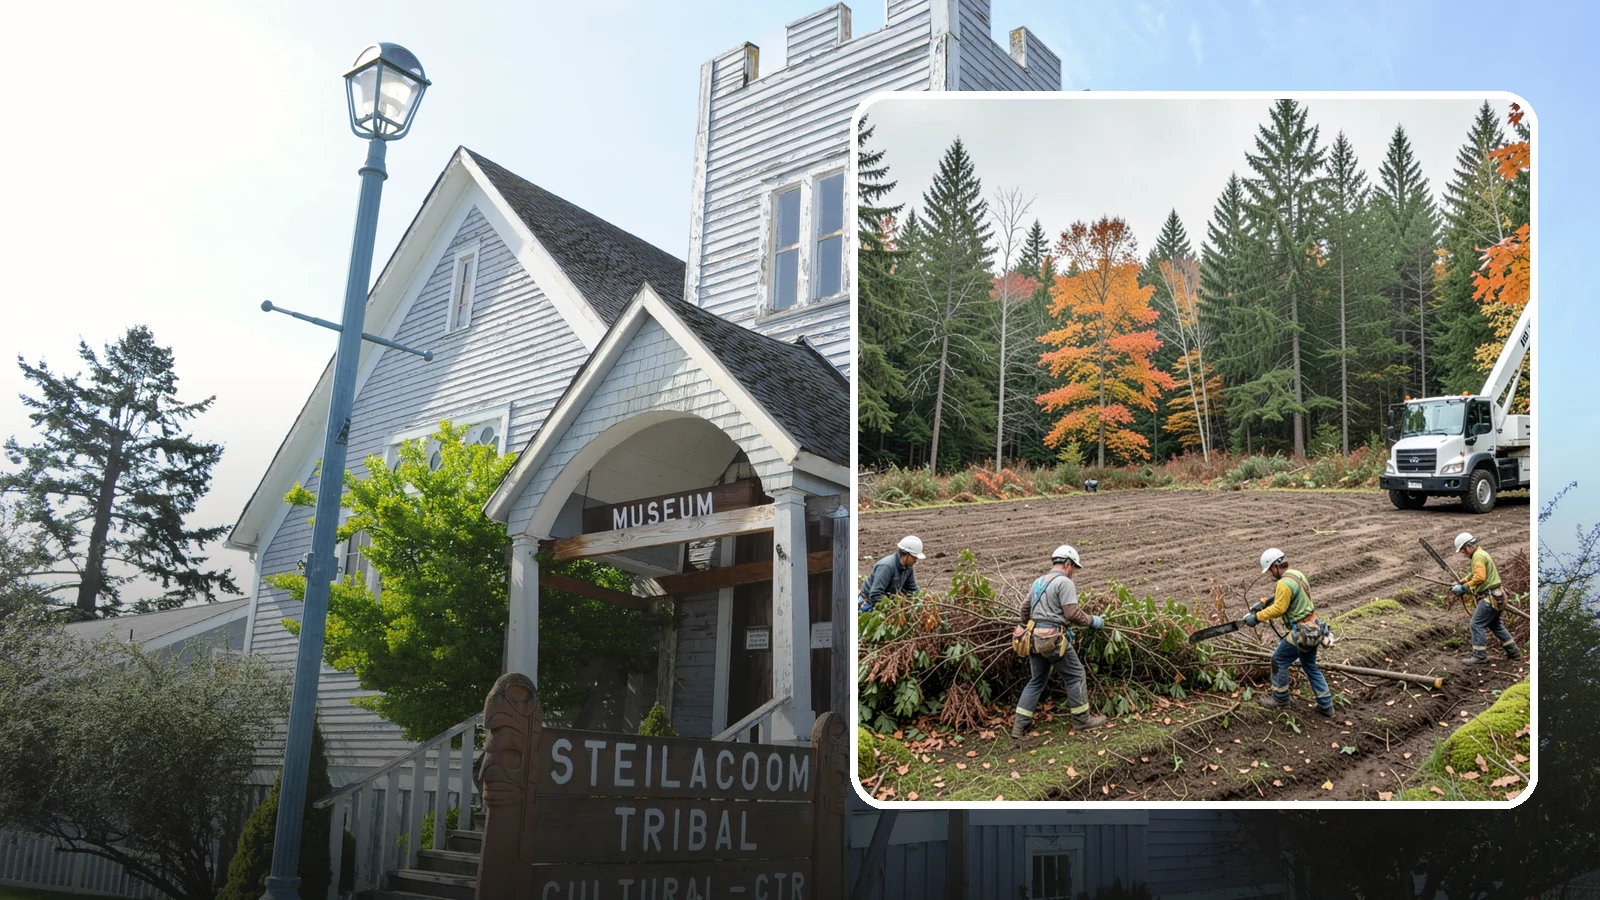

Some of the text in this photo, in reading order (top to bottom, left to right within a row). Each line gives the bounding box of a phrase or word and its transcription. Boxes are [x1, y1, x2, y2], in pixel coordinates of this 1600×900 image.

[613, 492, 713, 530] MUSEUM
[551, 738, 809, 792] STEILACOOM
[615, 806, 758, 851] TRIBAL
